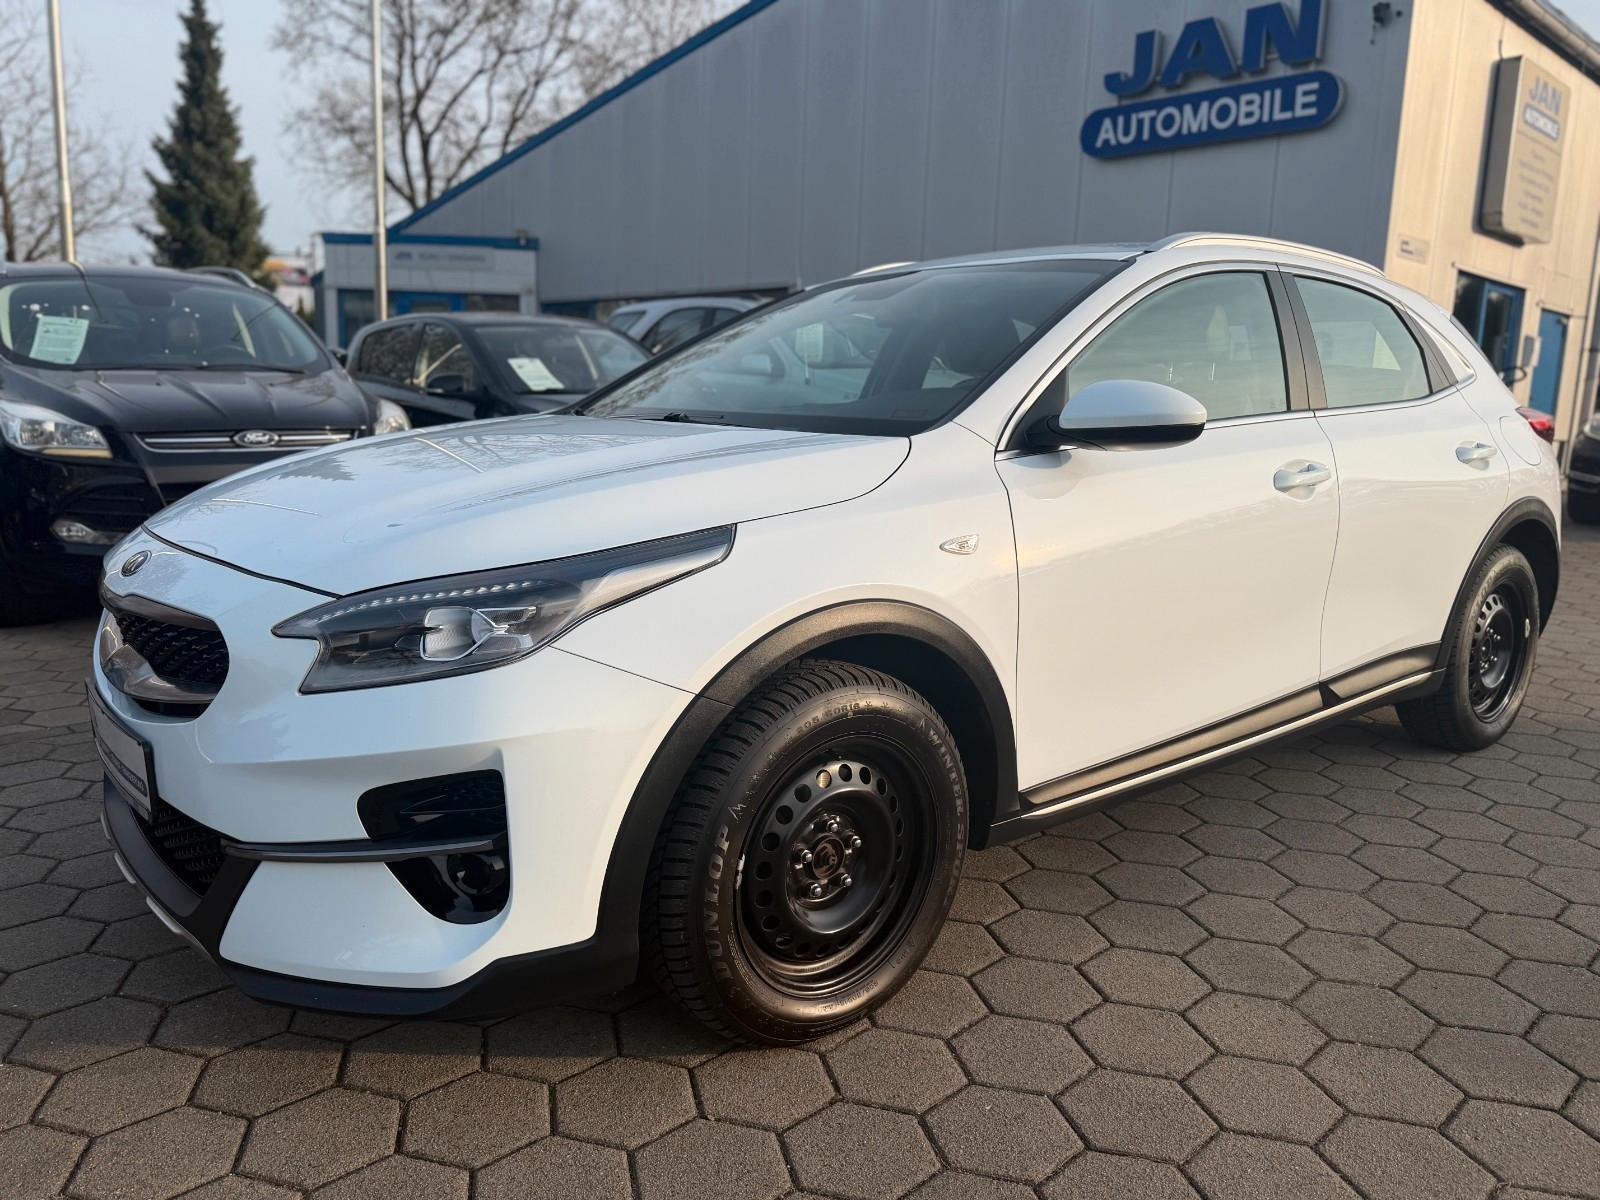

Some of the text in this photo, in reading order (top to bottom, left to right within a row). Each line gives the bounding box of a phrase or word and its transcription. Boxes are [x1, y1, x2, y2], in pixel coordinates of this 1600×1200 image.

[1104, 0, 1325, 95] JAN
[1095, 81, 1319, 148] AUTOMOBILE
[1529, 75, 1562, 115] JAN
[928, 727, 965, 816] WINTER
[704, 823, 732, 978] DUNLOP
